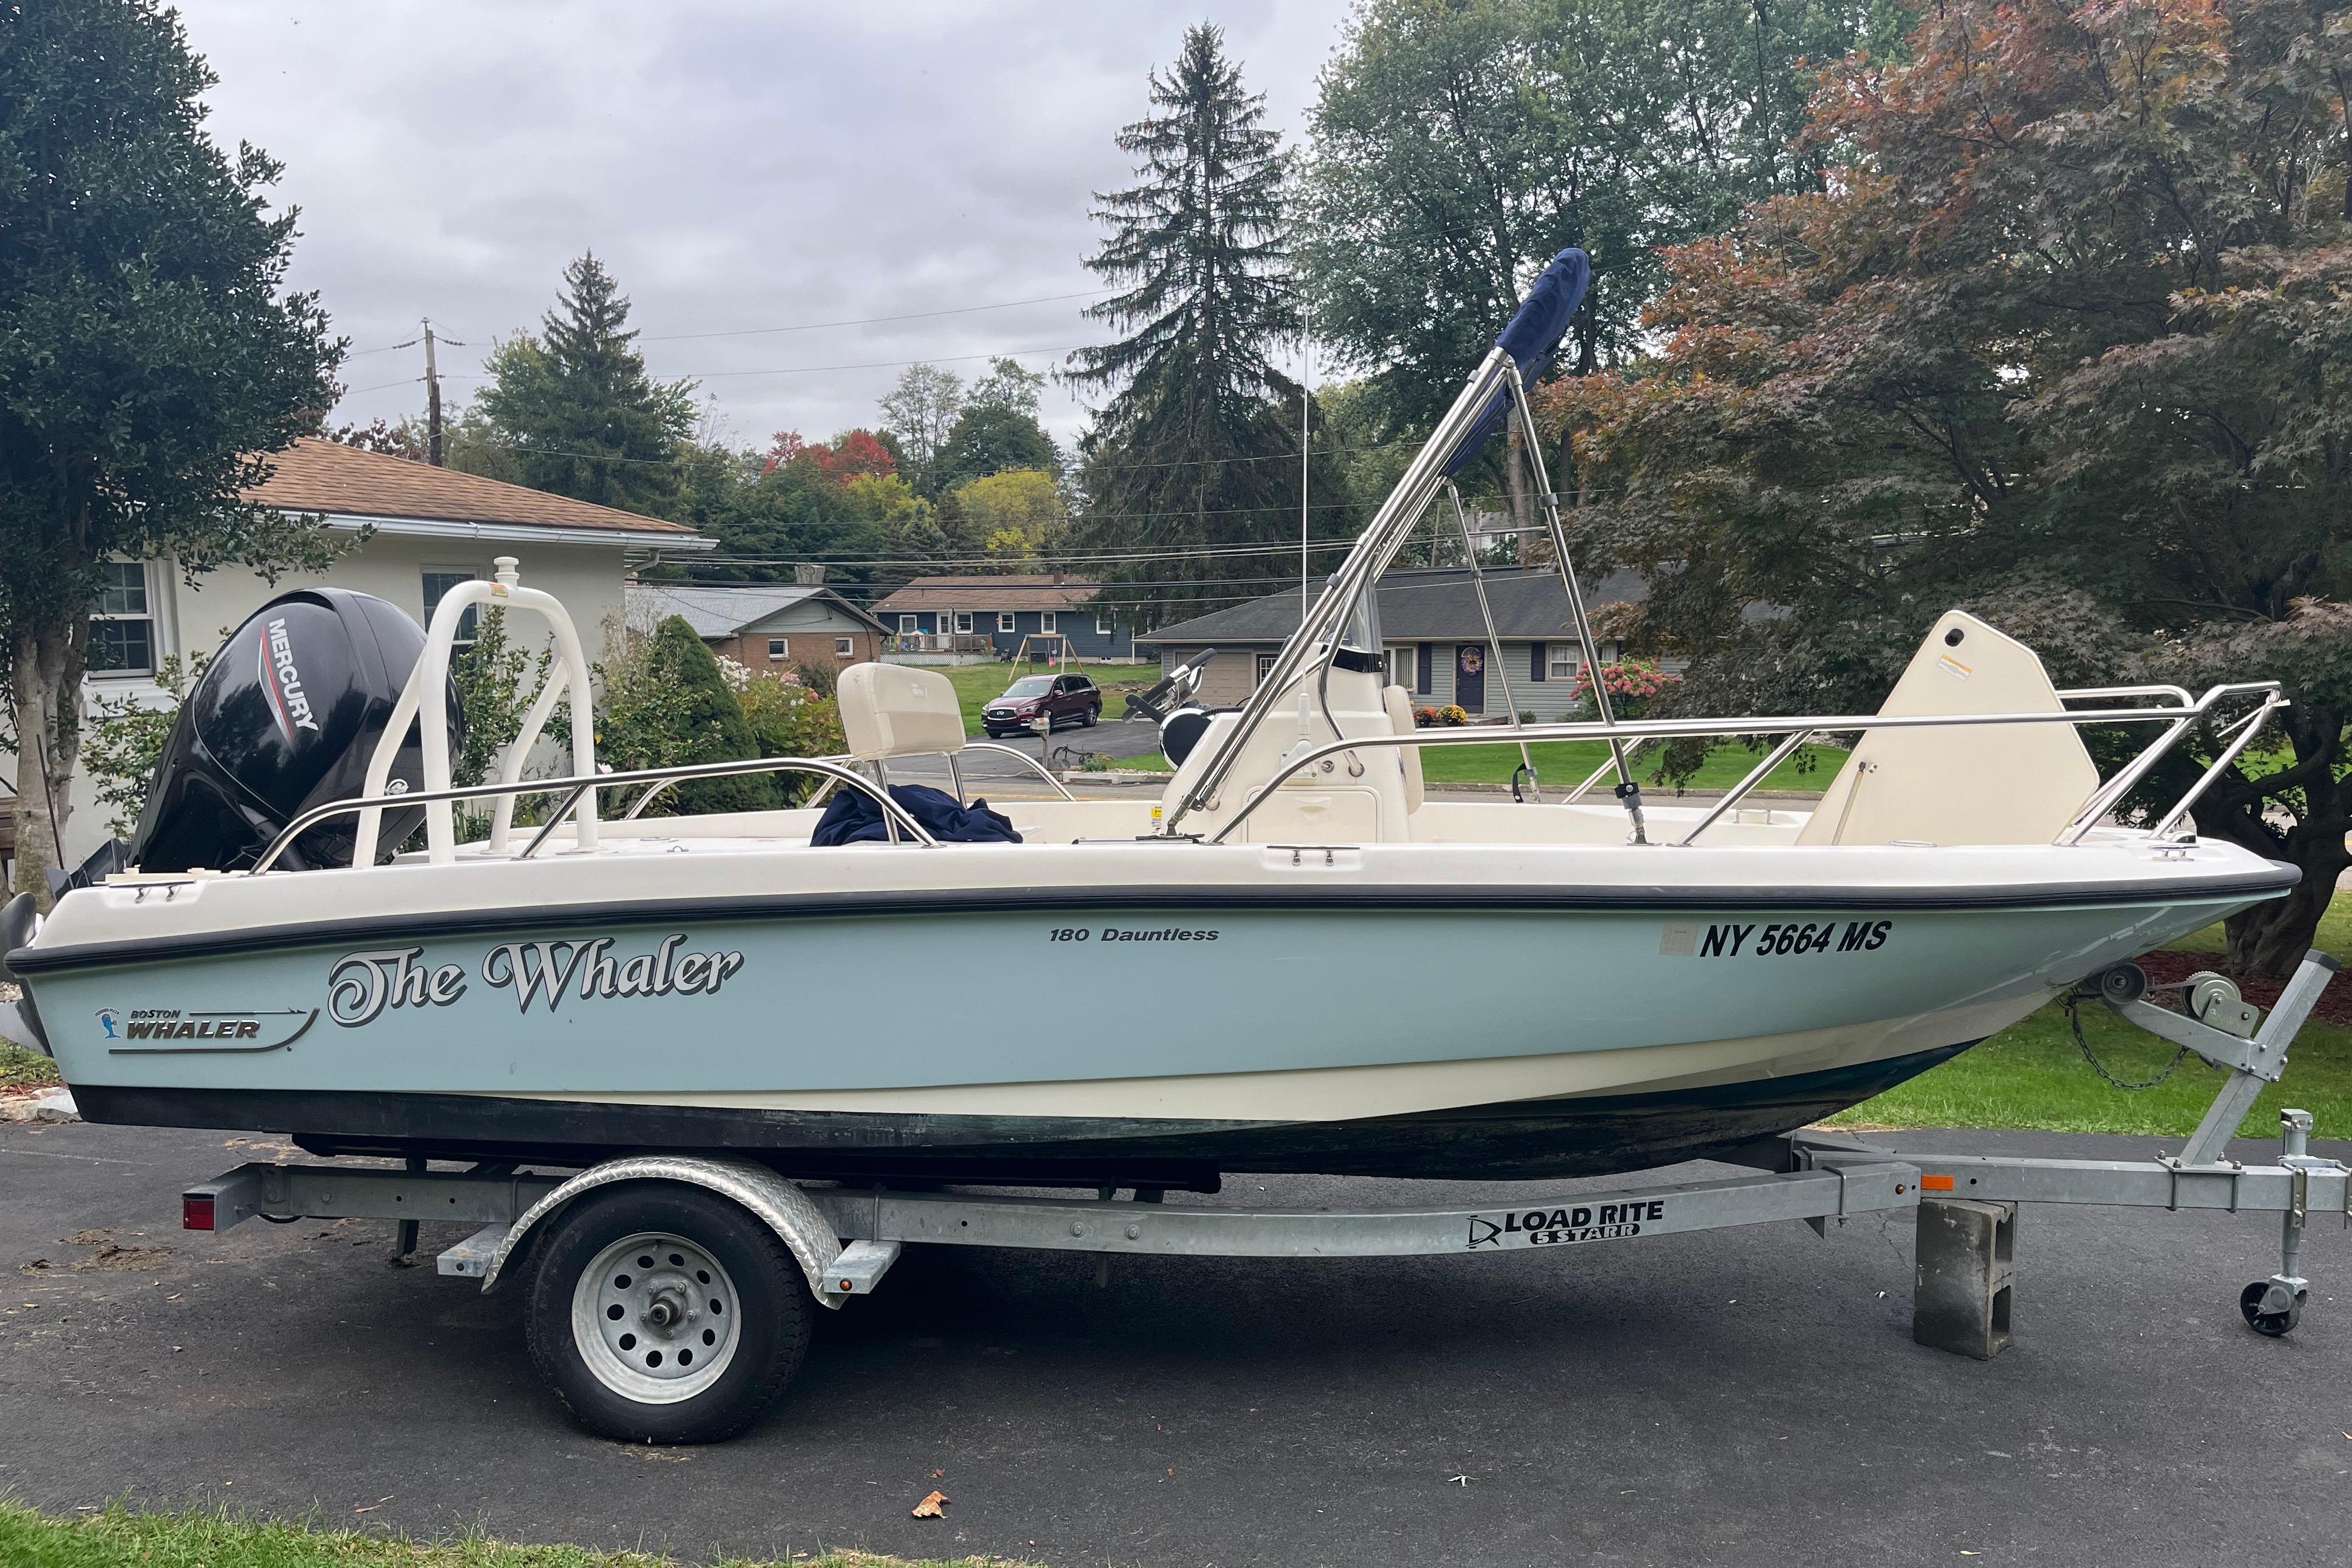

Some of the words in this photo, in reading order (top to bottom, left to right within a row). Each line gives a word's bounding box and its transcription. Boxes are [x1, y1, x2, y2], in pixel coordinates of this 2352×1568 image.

[268, 618, 319, 732] MERCURY
[1050, 928, 1090, 942] 180
[1101, 928, 1220, 942] Dauntless
[1699, 925, 1756, 957] NY
[1756, 922, 1836, 956] 5664
[1836, 921, 1892, 952] MS
[328, 946, 468, 1028] The
[482, 934, 745, 1015] Whaler
[131, 1010, 181, 1019] BOSTON
[127, 1020, 261, 1040] WHALER
[1504, 1208, 1592, 1233] LOAD
[1599, 1200, 1664, 1226] RITE
[1536, 1231, 1550, 1244] 5
[1556, 1224, 1635, 1243] STARR
